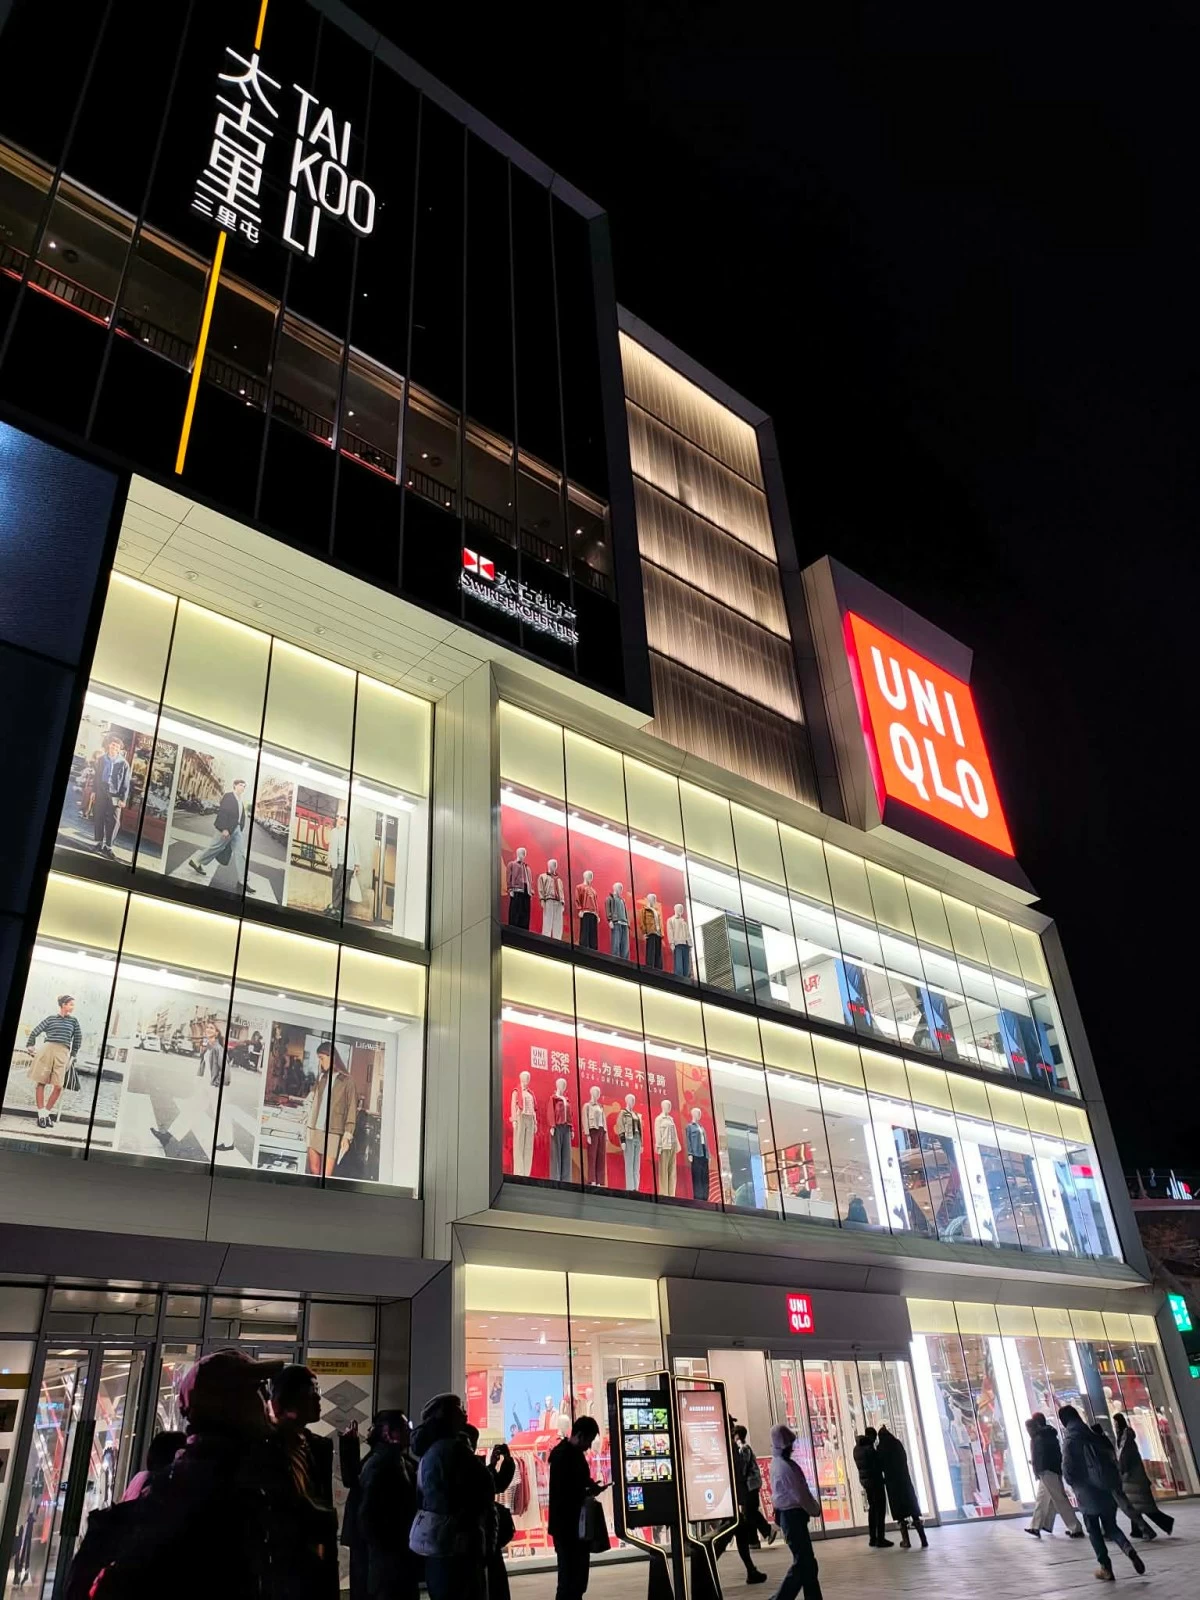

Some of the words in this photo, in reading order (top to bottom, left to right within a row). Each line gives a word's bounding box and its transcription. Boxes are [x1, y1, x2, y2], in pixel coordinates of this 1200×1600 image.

[196, 46, 281, 224] 太古里
[293, 83, 351, 167] TAI
[191, 191, 260, 244] 三里屯
[290, 138, 376, 235] KOO
[283, 189, 320, 258] LI
[870, 645, 965, 748] UNI
[889, 722, 989, 819] QLO
[532, 1049, 546, 1058] UNI
[532, 1057, 546, 1067] QLO
[789, 1298, 807, 1313] UNI
[791, 1313, 811, 1331] QLO
